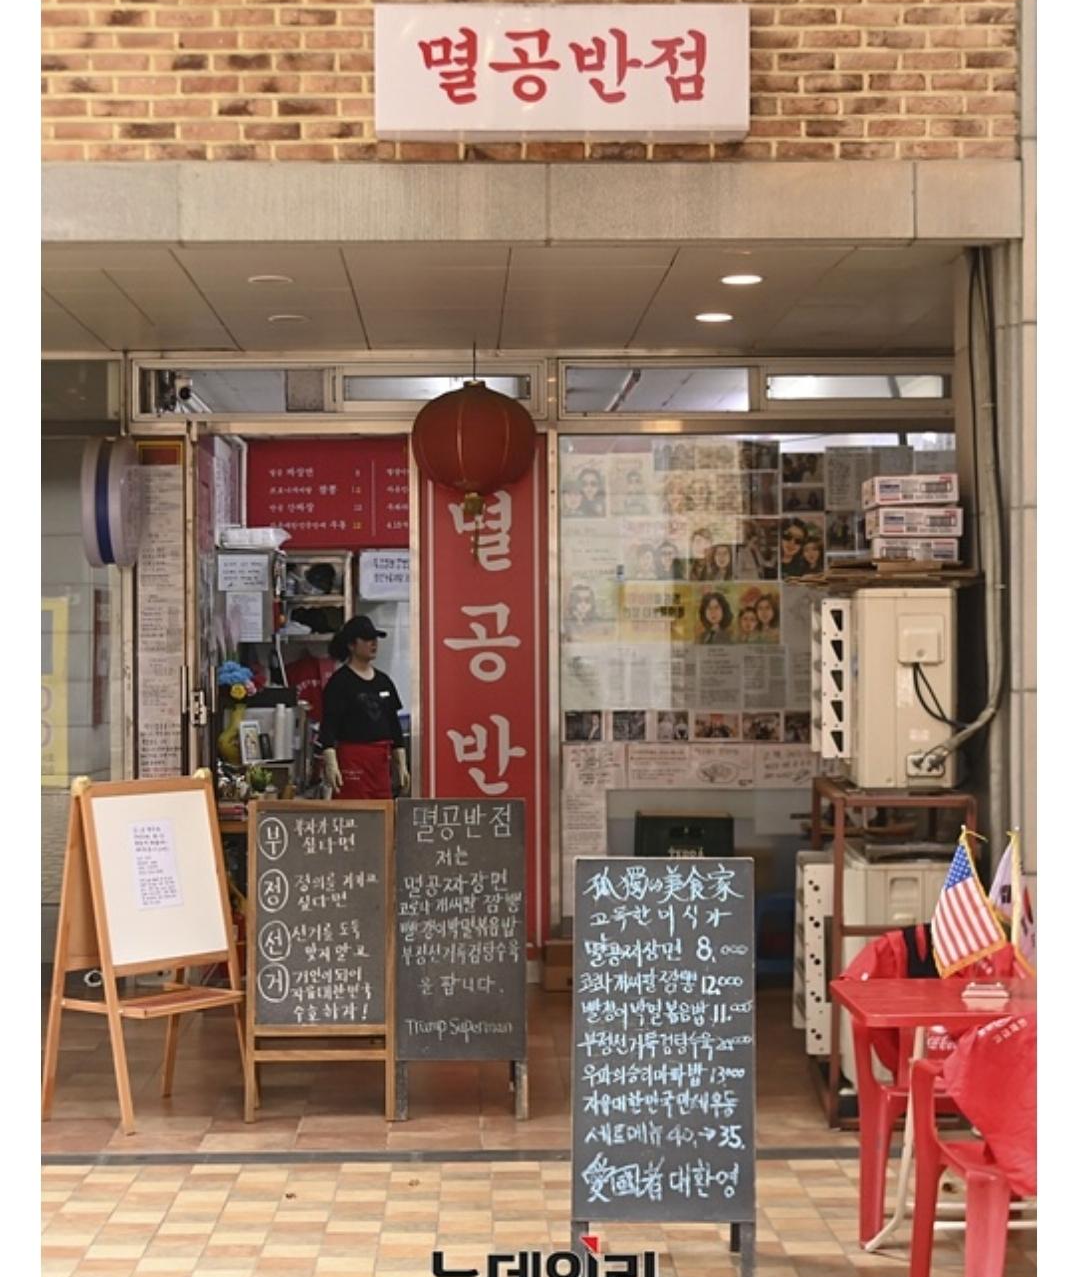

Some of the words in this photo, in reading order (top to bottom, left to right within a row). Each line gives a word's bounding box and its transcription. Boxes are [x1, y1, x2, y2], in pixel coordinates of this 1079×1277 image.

[419, 27, 710, 104] 멸공반점
[413, 804, 511, 842] 멸공반점
[436, 845, 468, 866] 저는
[669, 1158, 739, 1198] 대환영
